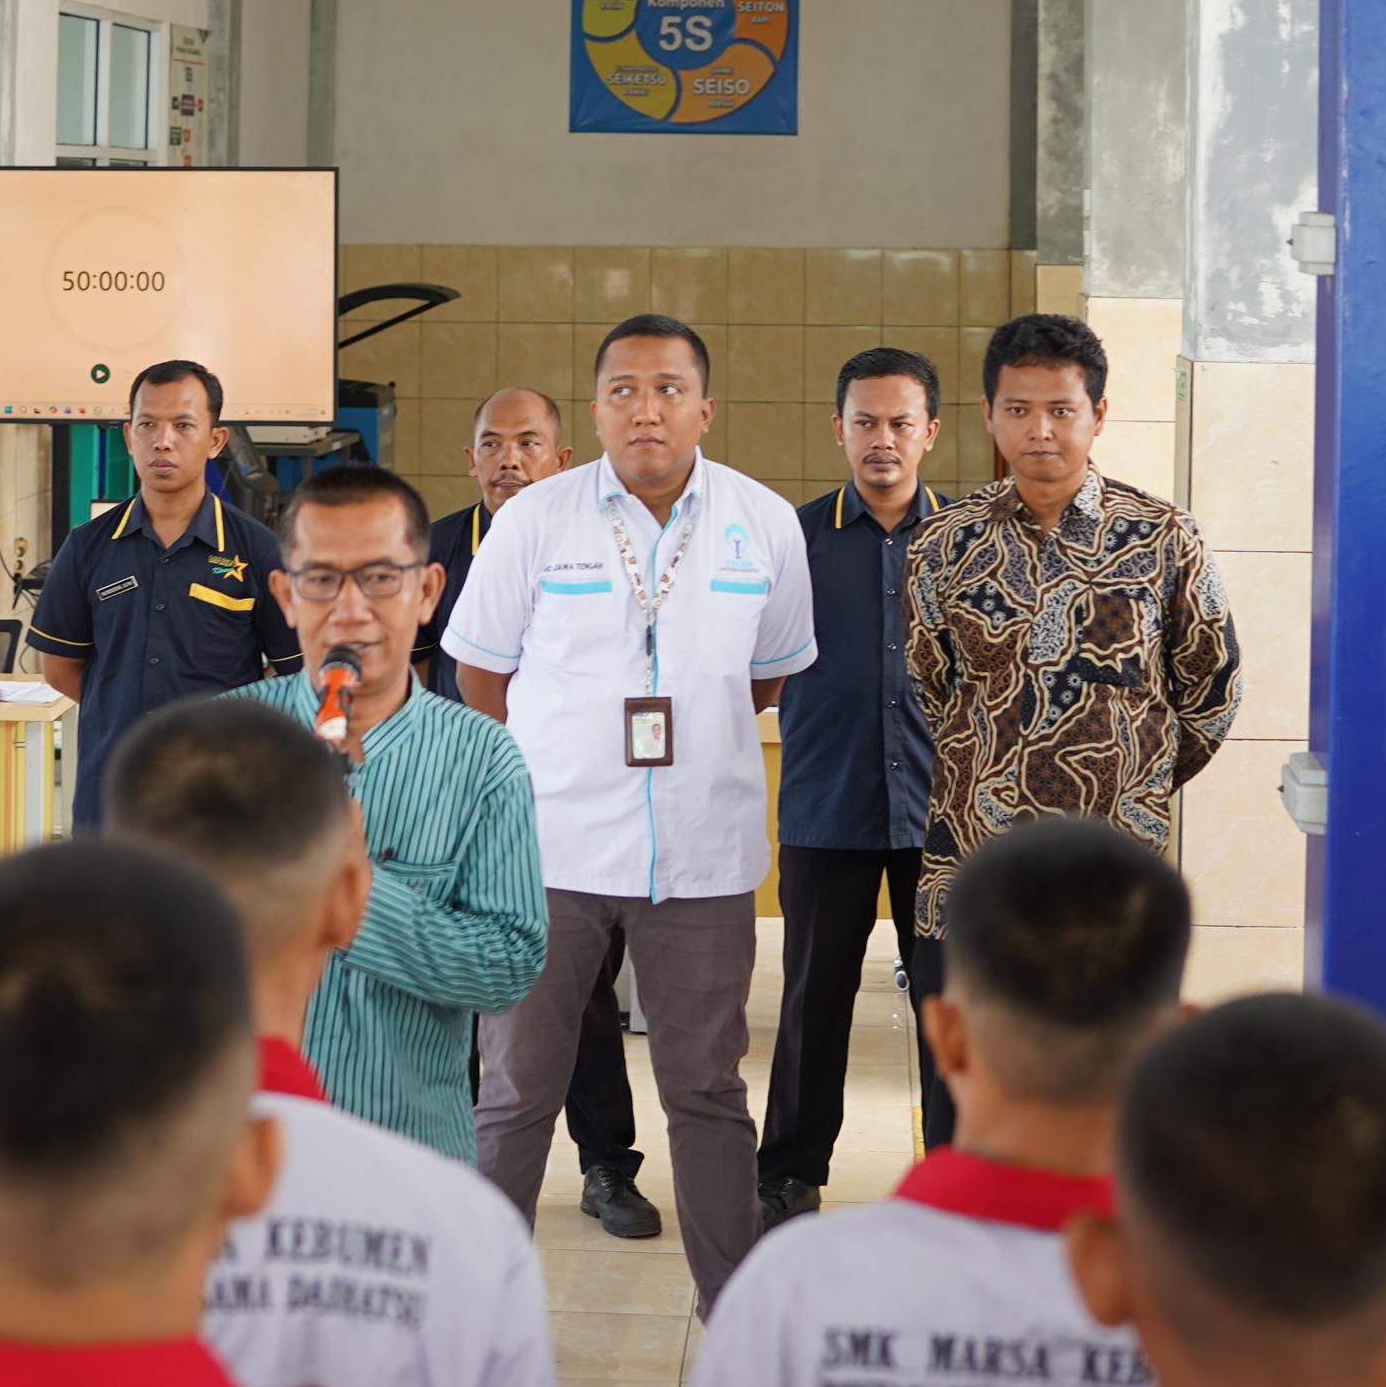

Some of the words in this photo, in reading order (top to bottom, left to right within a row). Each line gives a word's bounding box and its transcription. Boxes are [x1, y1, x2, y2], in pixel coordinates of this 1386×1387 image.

[736, 0, 785, 13] SEITON
[658, 15, 713, 52] 5S
[692, 78, 751, 96] SEISO
[62, 270, 165, 292] 50:00:00
[821, 1327, 897, 1369] SMK
[925, 1331, 1052, 1378] MARSA
